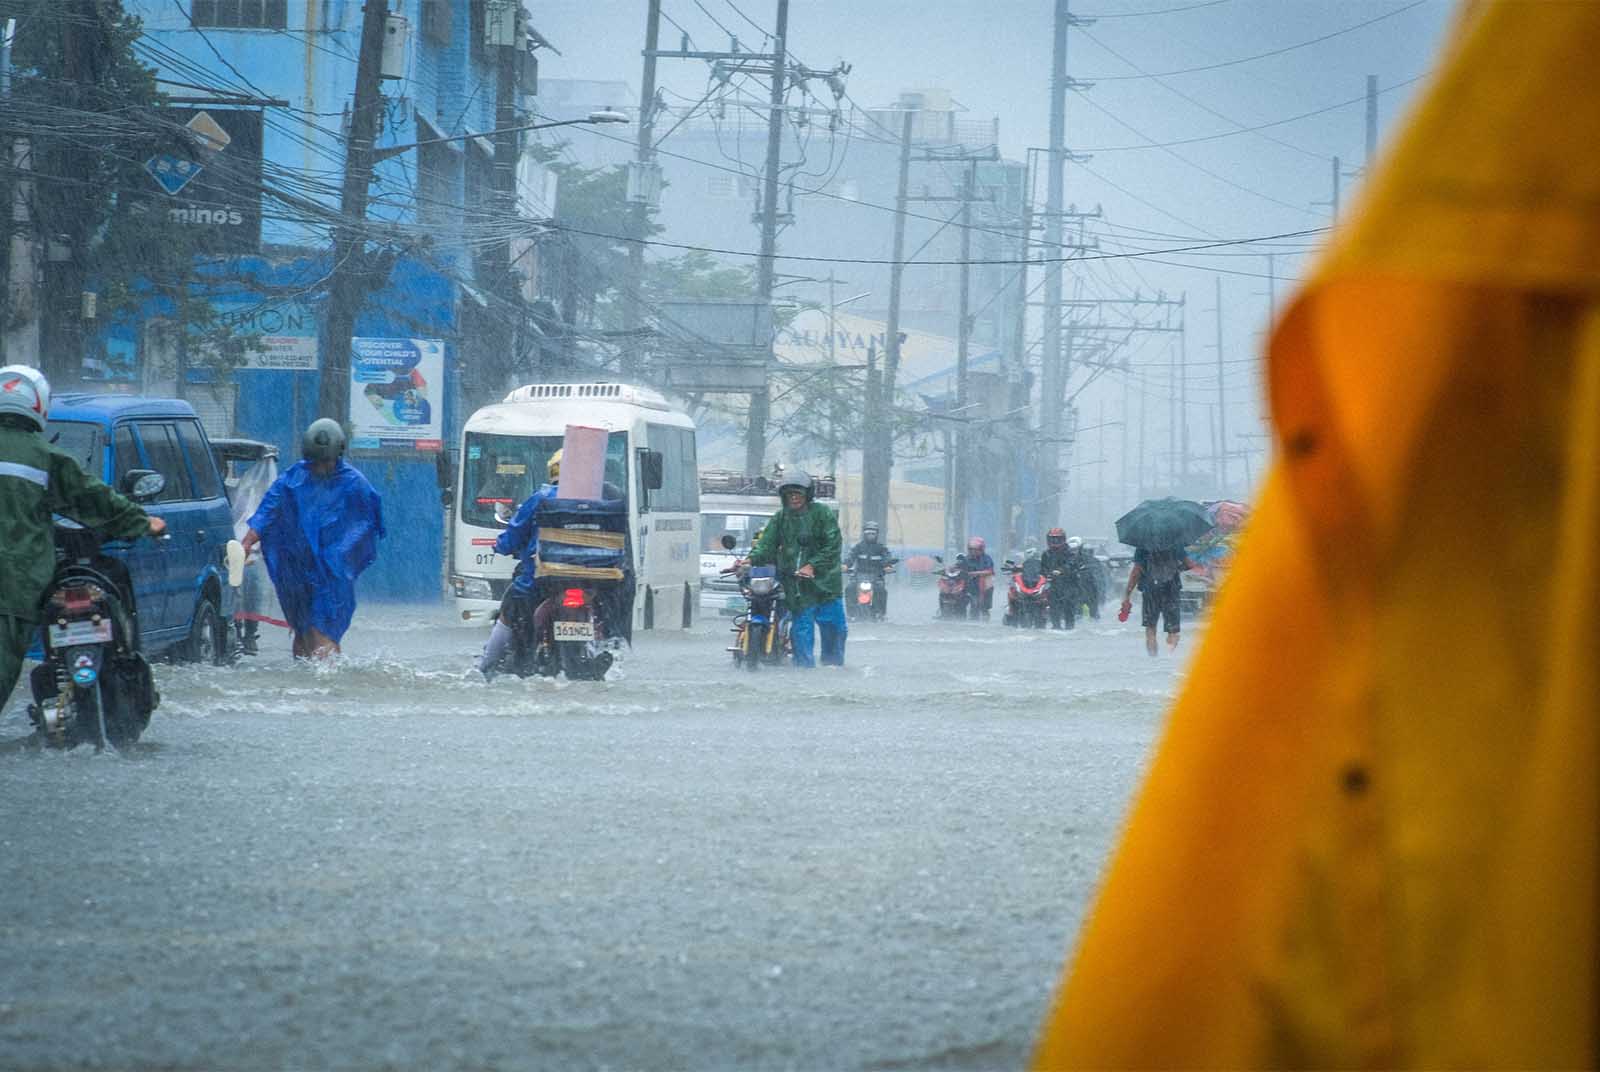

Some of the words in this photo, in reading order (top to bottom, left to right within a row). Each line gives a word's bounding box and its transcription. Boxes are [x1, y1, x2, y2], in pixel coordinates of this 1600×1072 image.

[135, 203, 243, 225] mino's
[206, 309, 304, 333] UMON
[360, 350, 383, 358] YOUR
[359, 358, 405, 366] POTENTIAL
[476, 553, 495, 565] 017
